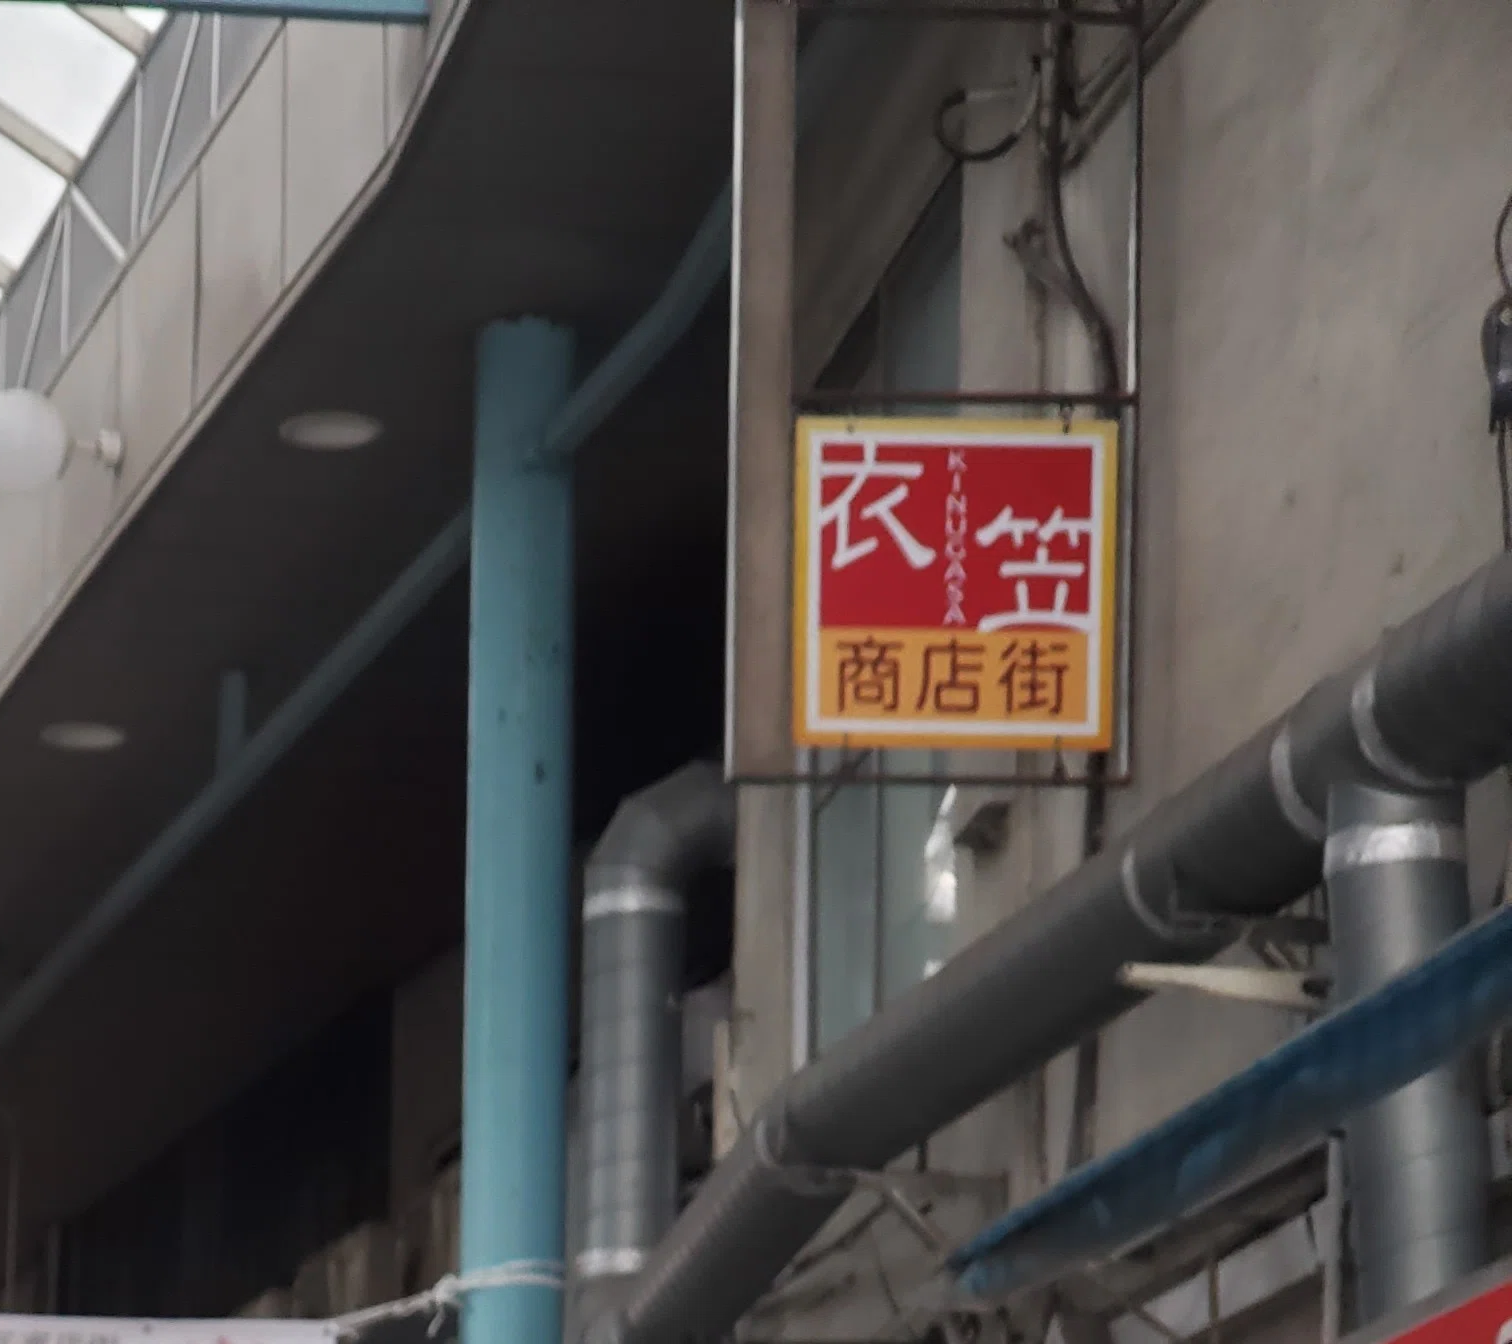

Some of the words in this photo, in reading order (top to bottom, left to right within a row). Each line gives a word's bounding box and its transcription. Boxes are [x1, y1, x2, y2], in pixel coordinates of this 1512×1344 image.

[821, 441, 1092, 633] 衣笠
[835, 635, 1070, 716] 商店街
